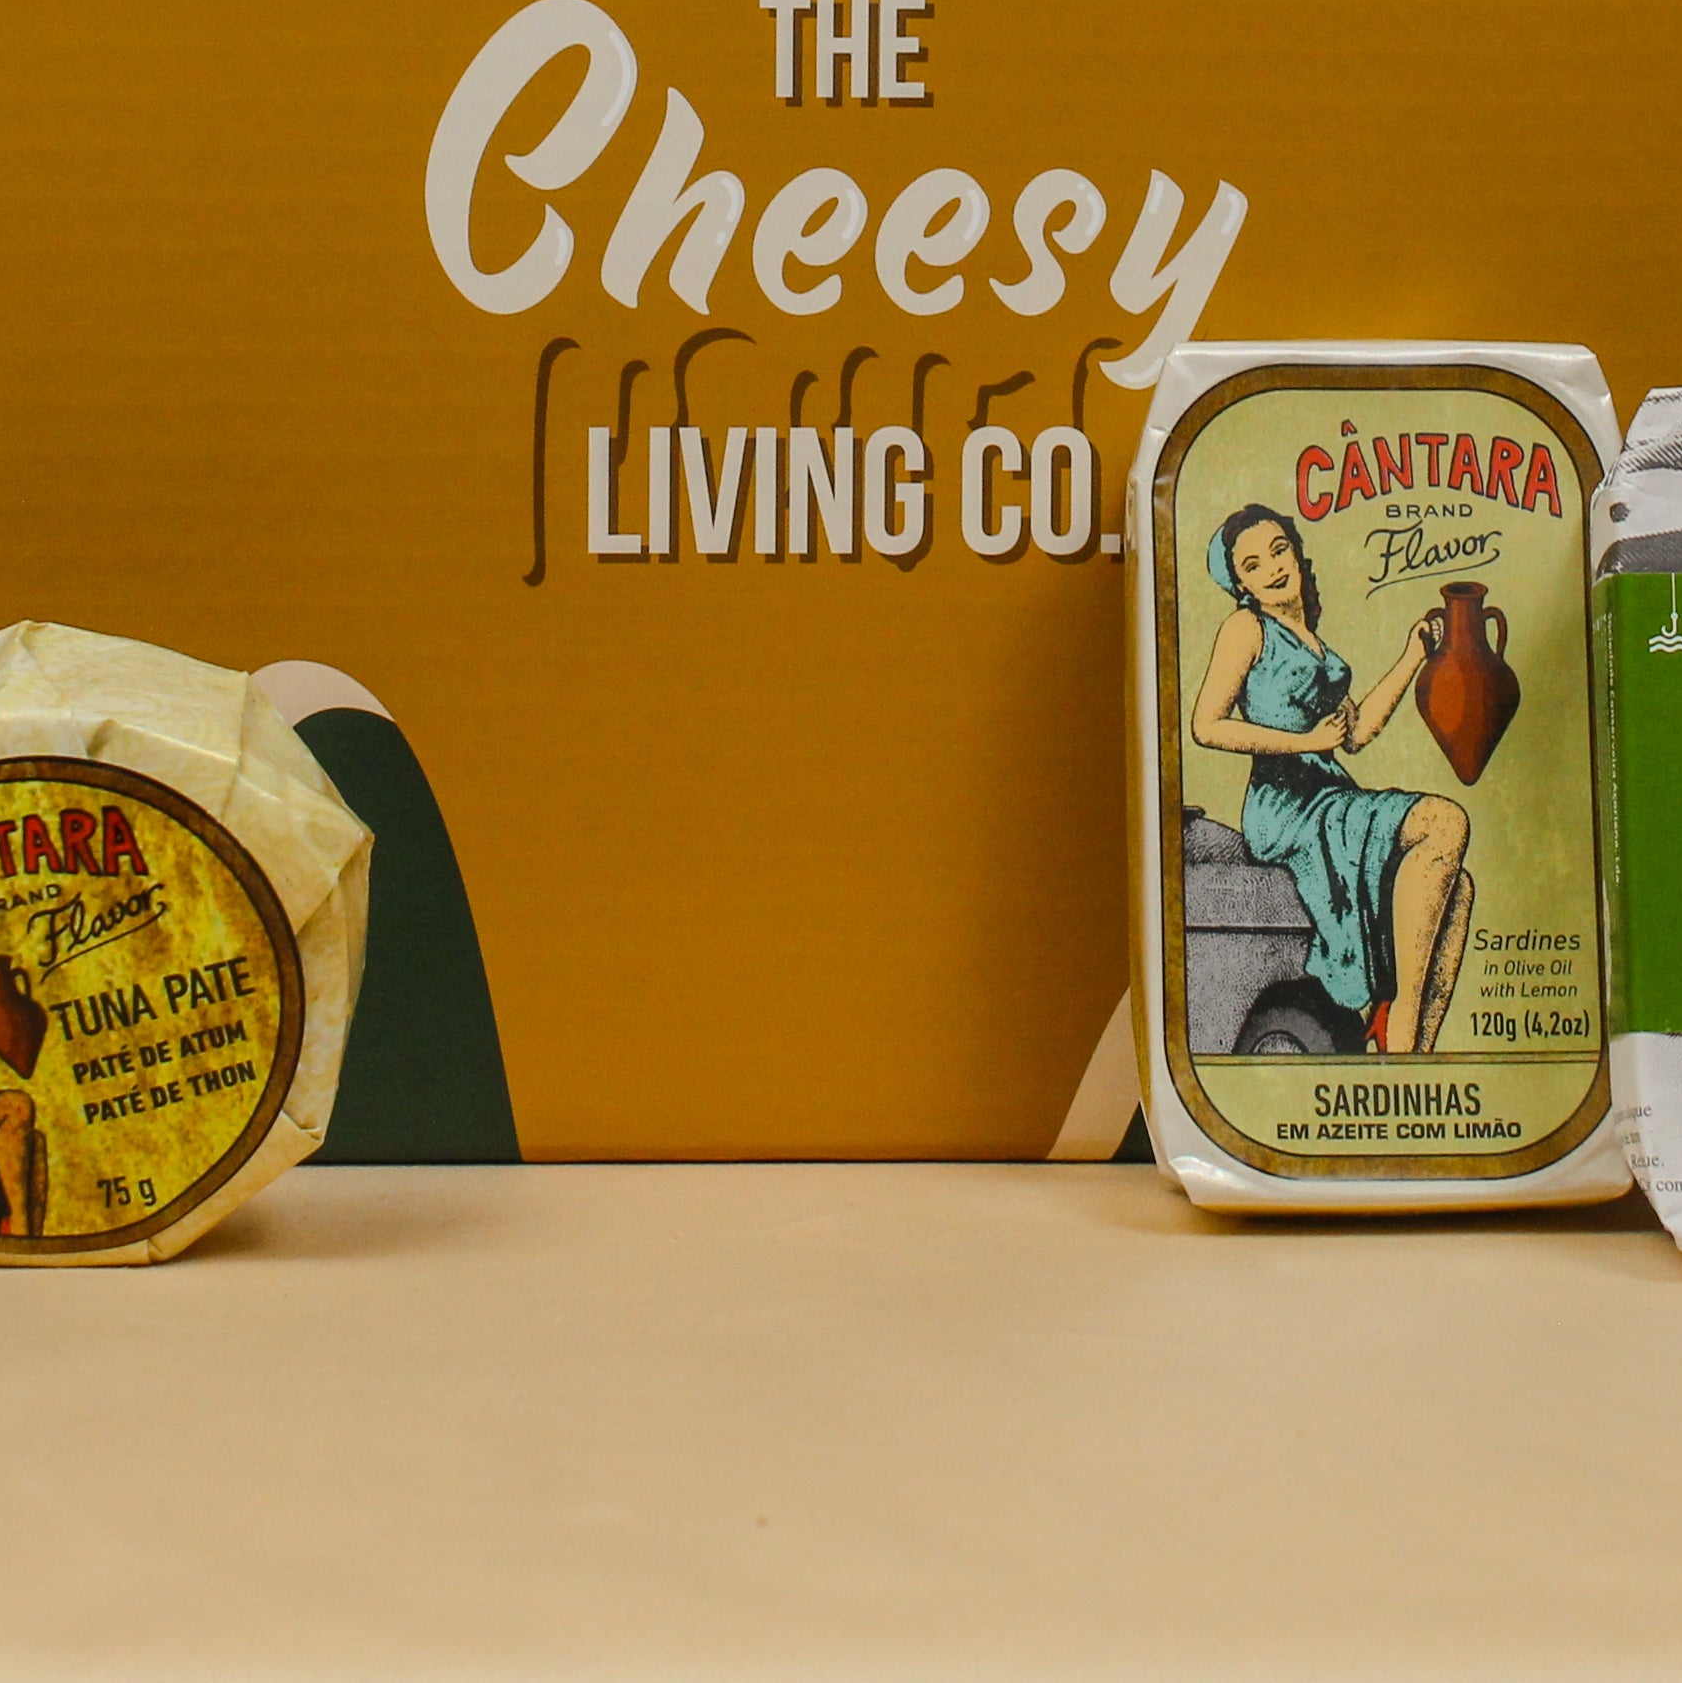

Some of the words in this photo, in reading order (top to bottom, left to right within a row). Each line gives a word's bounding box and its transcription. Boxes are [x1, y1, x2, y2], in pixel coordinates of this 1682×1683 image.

[1295, 418, 1563, 523] CÂNTARA
[588, 426, 928, 557] LIVING
[961, 426, 1121, 556] CO.
[1385, 503, 1473, 518] BRAND
[1364, 519, 1503, 587] Flavor
[27, 881, 167, 974] Flavor
[1473, 929, 1581, 952] Sardines
[1484, 960, 1499, 975] in
[1503, 960, 1546, 976] Olive
[1550, 960, 1572, 976] Oil
[49, 983, 158, 1042] TUNA
[163, 956, 256, 1015] PATE
[1480, 981, 1515, 998] with
[1520, 981, 1578, 998] Lemon
[1470, 1011, 1517, 1042] 120g
[1523, 1009, 1591, 1041] (4,2oz)
[72, 1044, 135, 1085] PATÉ
[139, 1040, 173, 1068] DE
[179, 1020, 248, 1059] ATUM
[83, 1084, 146, 1125] PATÉ
[149, 1081, 183, 1110] DE
[186, 1060, 257, 1097] THON
[1314, 1083, 1481, 1117] SARDINHAS
[1276, 1123, 1309, 1140] EM
[1317, 1123, 1388, 1140] AZEITE
[1396, 1122, 1446, 1139] COM
[1454, 1118, 1522, 1138] LIMÃO
[97, 1176, 131, 1209] 75
[137, 1177, 157, 1207] g
